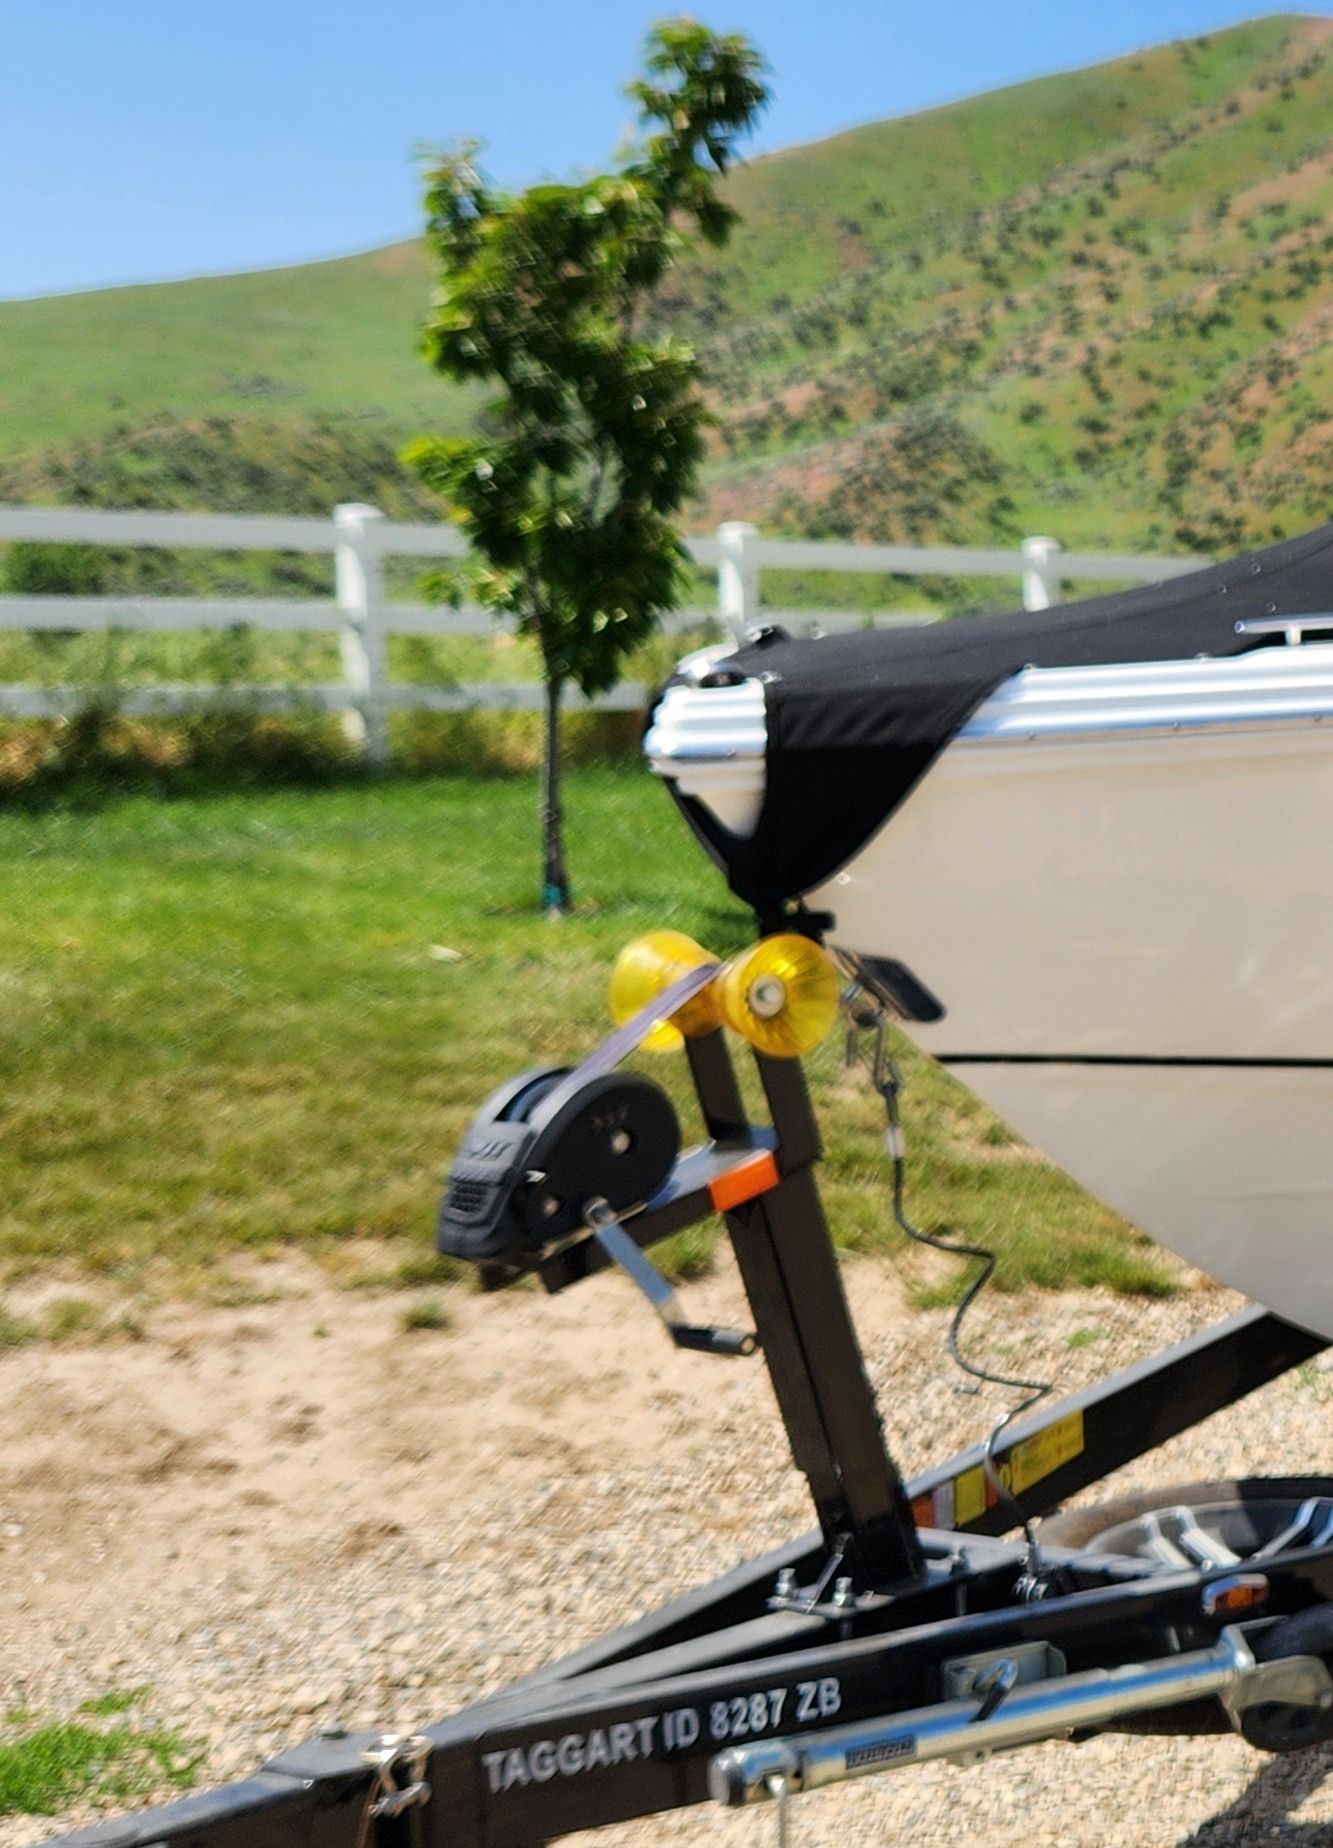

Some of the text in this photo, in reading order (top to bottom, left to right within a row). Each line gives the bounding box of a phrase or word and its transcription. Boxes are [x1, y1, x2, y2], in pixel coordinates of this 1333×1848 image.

[482, 1677, 842, 1793] TAGGART ID 8287 ZB
